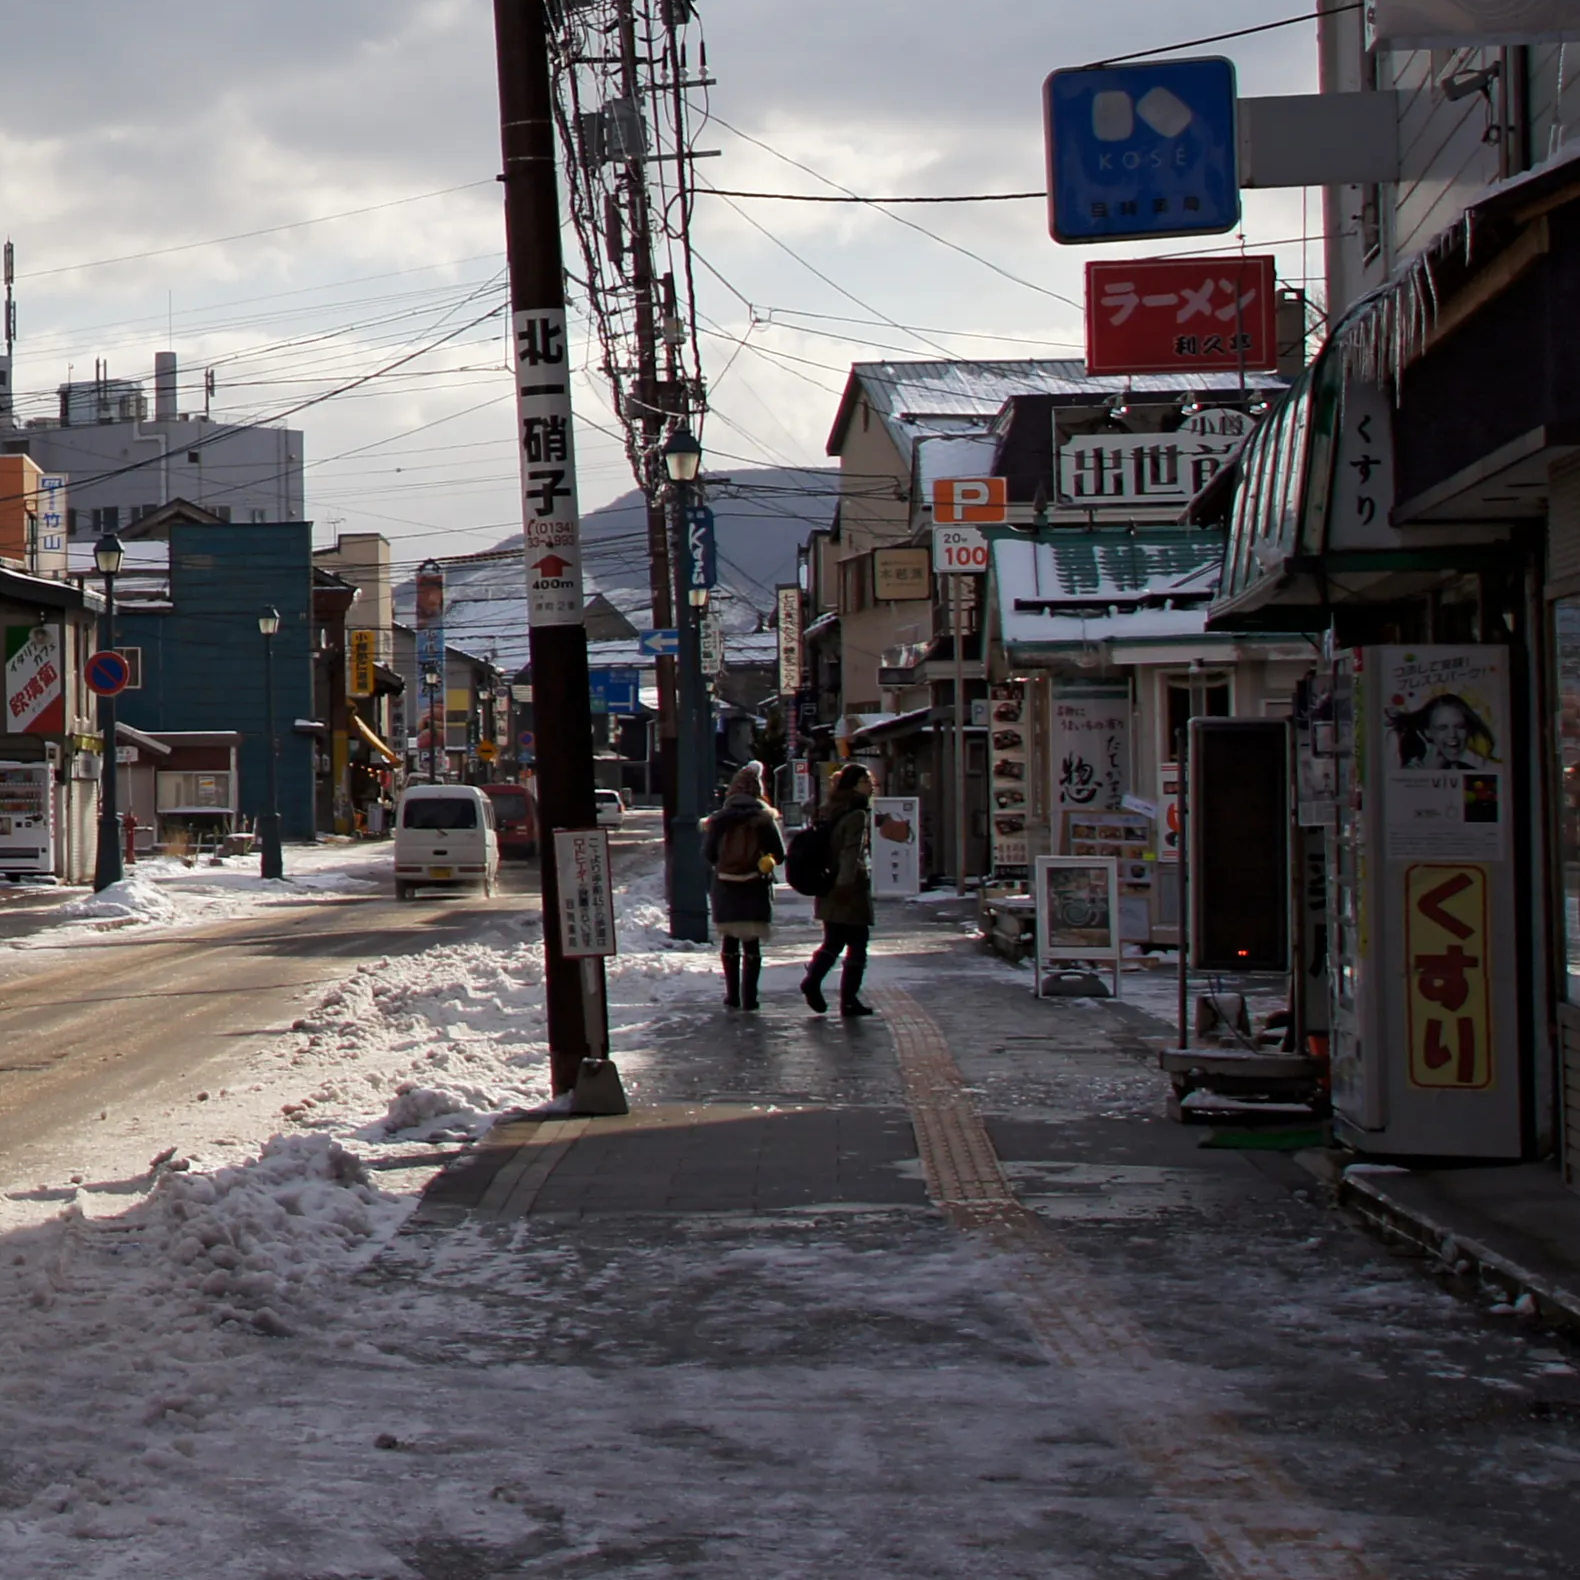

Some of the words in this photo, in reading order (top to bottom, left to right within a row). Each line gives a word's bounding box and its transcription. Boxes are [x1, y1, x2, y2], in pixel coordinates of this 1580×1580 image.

[1101, 277, 1257, 327] ラーメン
[519, 317, 570, 517] 北一硝子
[1349, 414, 1382, 527] くすり
[953, 481, 990, 520] P
[43, 512, 61, 551] 竹山
[532, 579, 574, 590] 400m
[1414, 872, 1480, 1084] くすり
